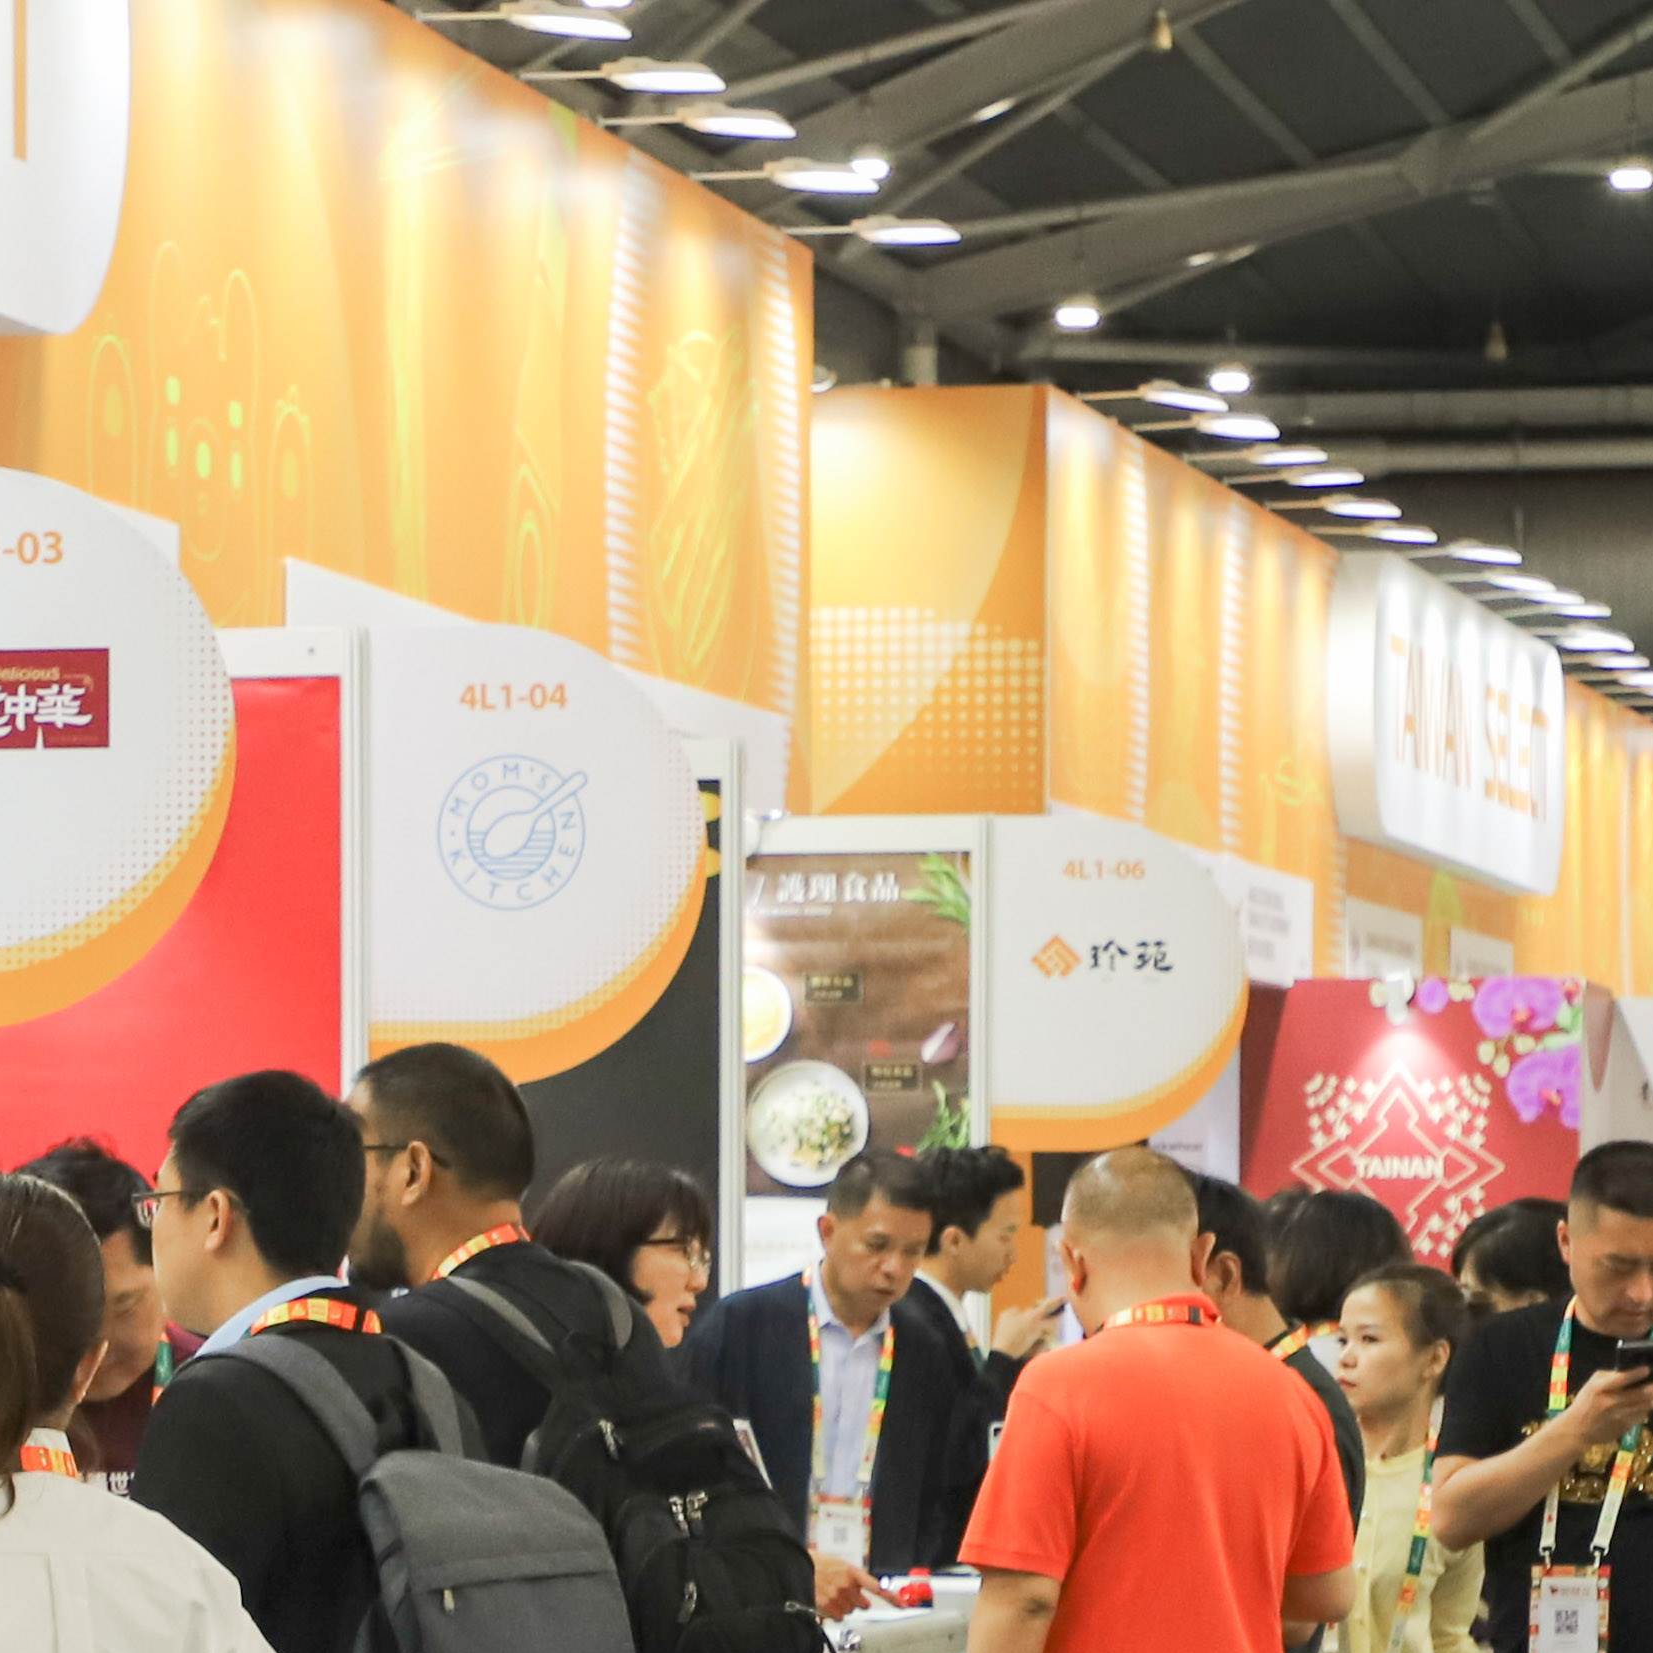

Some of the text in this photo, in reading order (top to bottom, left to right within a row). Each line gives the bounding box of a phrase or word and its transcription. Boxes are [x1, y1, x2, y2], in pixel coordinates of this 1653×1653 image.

[458, 682, 569, 711] 4L1-04
[1063, 860, 1146, 881] 4L1-06
[1355, 1155, 1444, 1179] TAINAN
